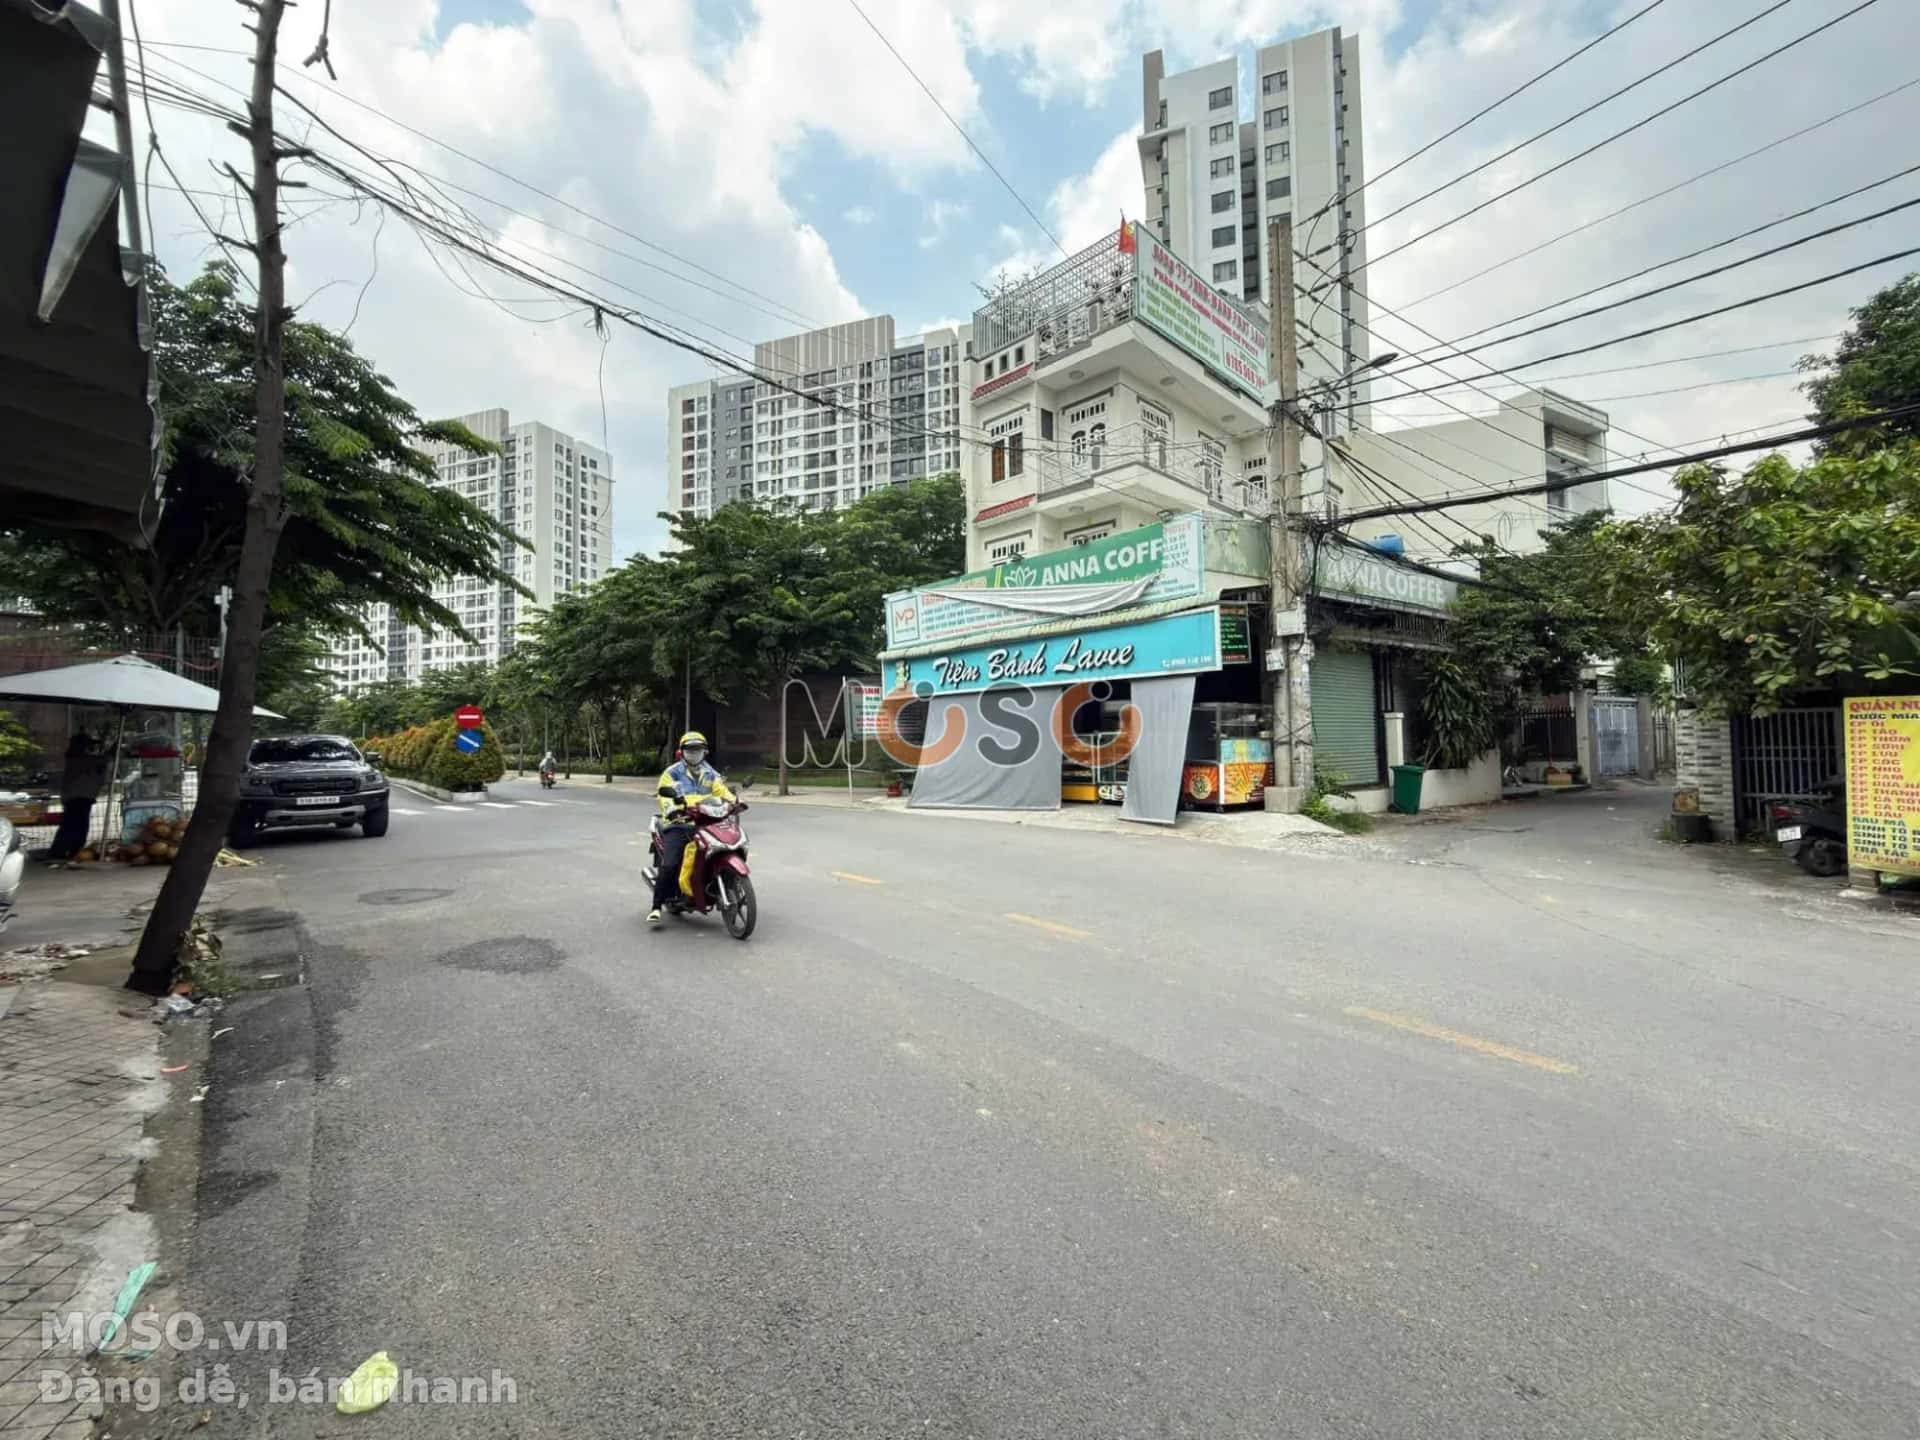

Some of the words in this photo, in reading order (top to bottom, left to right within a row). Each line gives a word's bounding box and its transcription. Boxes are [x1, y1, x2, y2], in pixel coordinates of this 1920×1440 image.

[1041, 555, 1102, 586] ANNA
[1103, 538, 1163, 571] COFF
[1326, 556, 1382, 590] ANNA
[1384, 571, 1444, 602] COFFEE
[932, 656, 982, 688] Tiệm
[986, 642, 1047, 680] Bánh
[1053, 637, 1135, 673] Lavie
